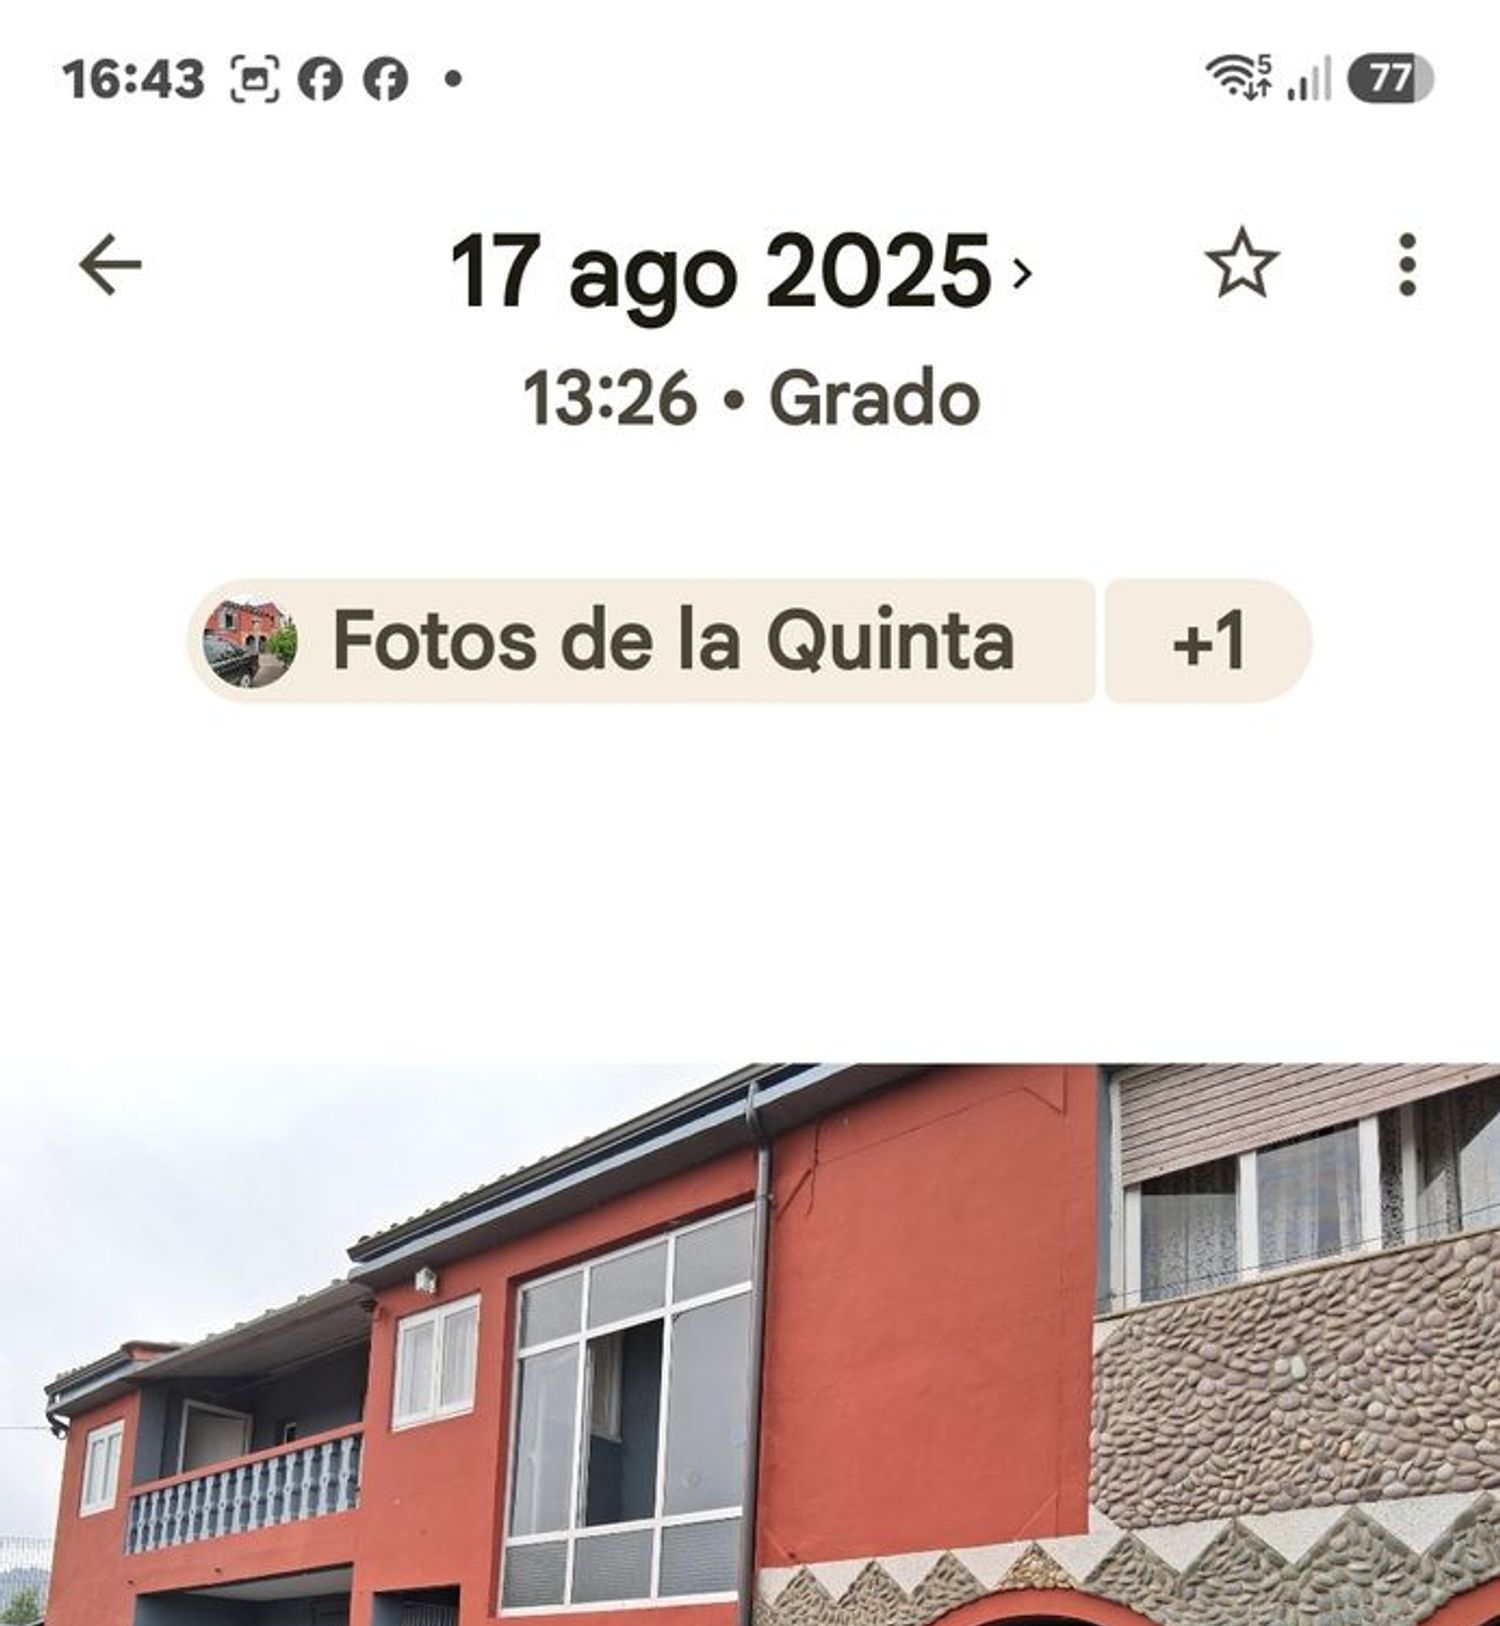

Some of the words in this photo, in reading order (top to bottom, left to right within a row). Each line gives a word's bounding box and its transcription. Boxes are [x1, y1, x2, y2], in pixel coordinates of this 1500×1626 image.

[63, 58, 205, 99] 16:43
[1258, 54, 1272, 75] 5
[1369, 62, 1413, 92] 77
[452, 232, 541, 307] 17
[570, 249, 738, 330] ago
[767, 231, 992, 309] 2025
[524, 368, 697, 426] 13:26
[770, 364, 981, 426] Grado
[335, 608, 537, 671] Fotos
[561, 604, 653, 671] de
[680, 604, 740, 671] la
[767, 604, 1014, 674] Quinta
[1173, 608, 1242, 670] +1
